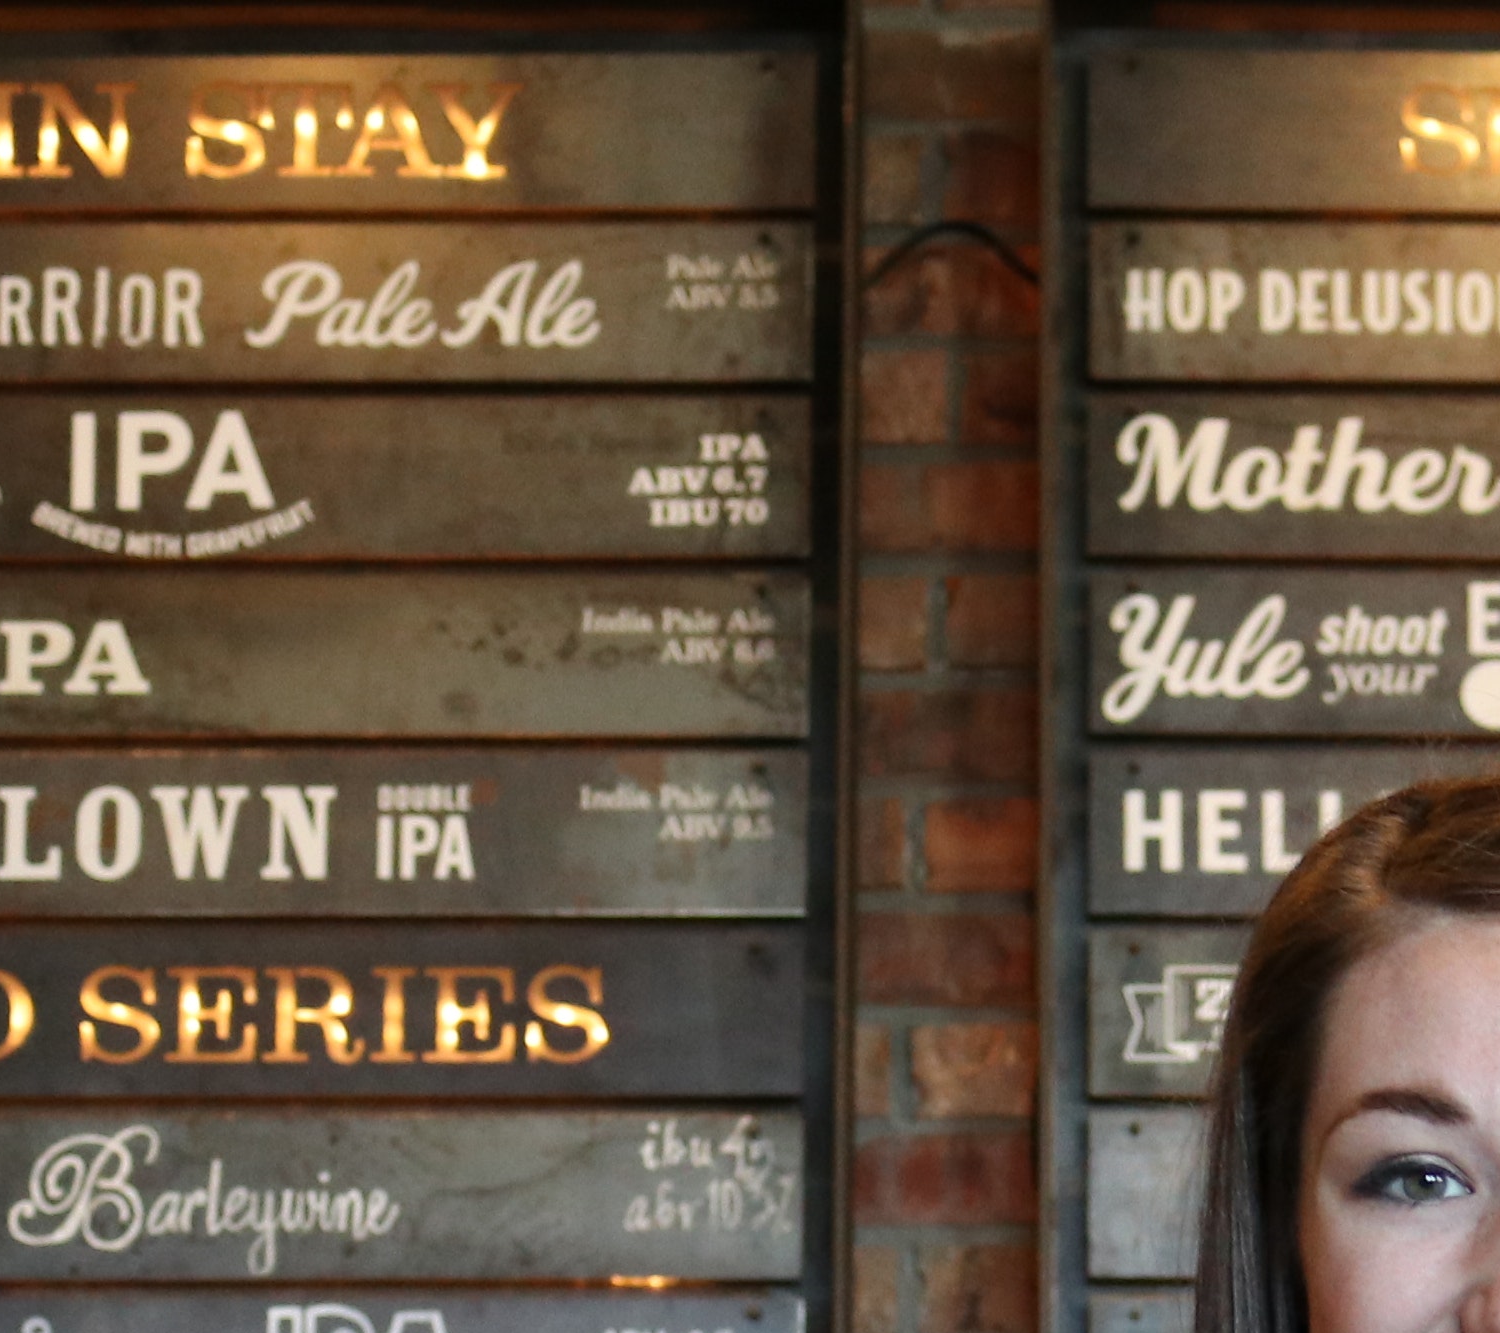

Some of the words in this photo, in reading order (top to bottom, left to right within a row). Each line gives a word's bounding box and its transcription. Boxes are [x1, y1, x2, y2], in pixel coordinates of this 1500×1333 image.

[185, 80, 524, 181] STAY
[244, 257, 438, 350] Pale
[440, 257, 602, 350] Ale
[1121, 267, 1245, 334] HOP
[69, 407, 275, 512] IPA
[627, 465, 709, 497] ABV
[698, 433, 770, 463] IPA
[648, 497, 720, 528] IBU
[1101, 593, 1312, 726] Yule
[1315, 605, 1450, 657] shoot
[1321, 660, 1440, 704] your
[376, 783, 472, 812] DOUBLE
[374, 814, 476, 882] IPA
[78, 963, 610, 1067] SERIES
[7, 1123, 399, 1278] Barleywine
